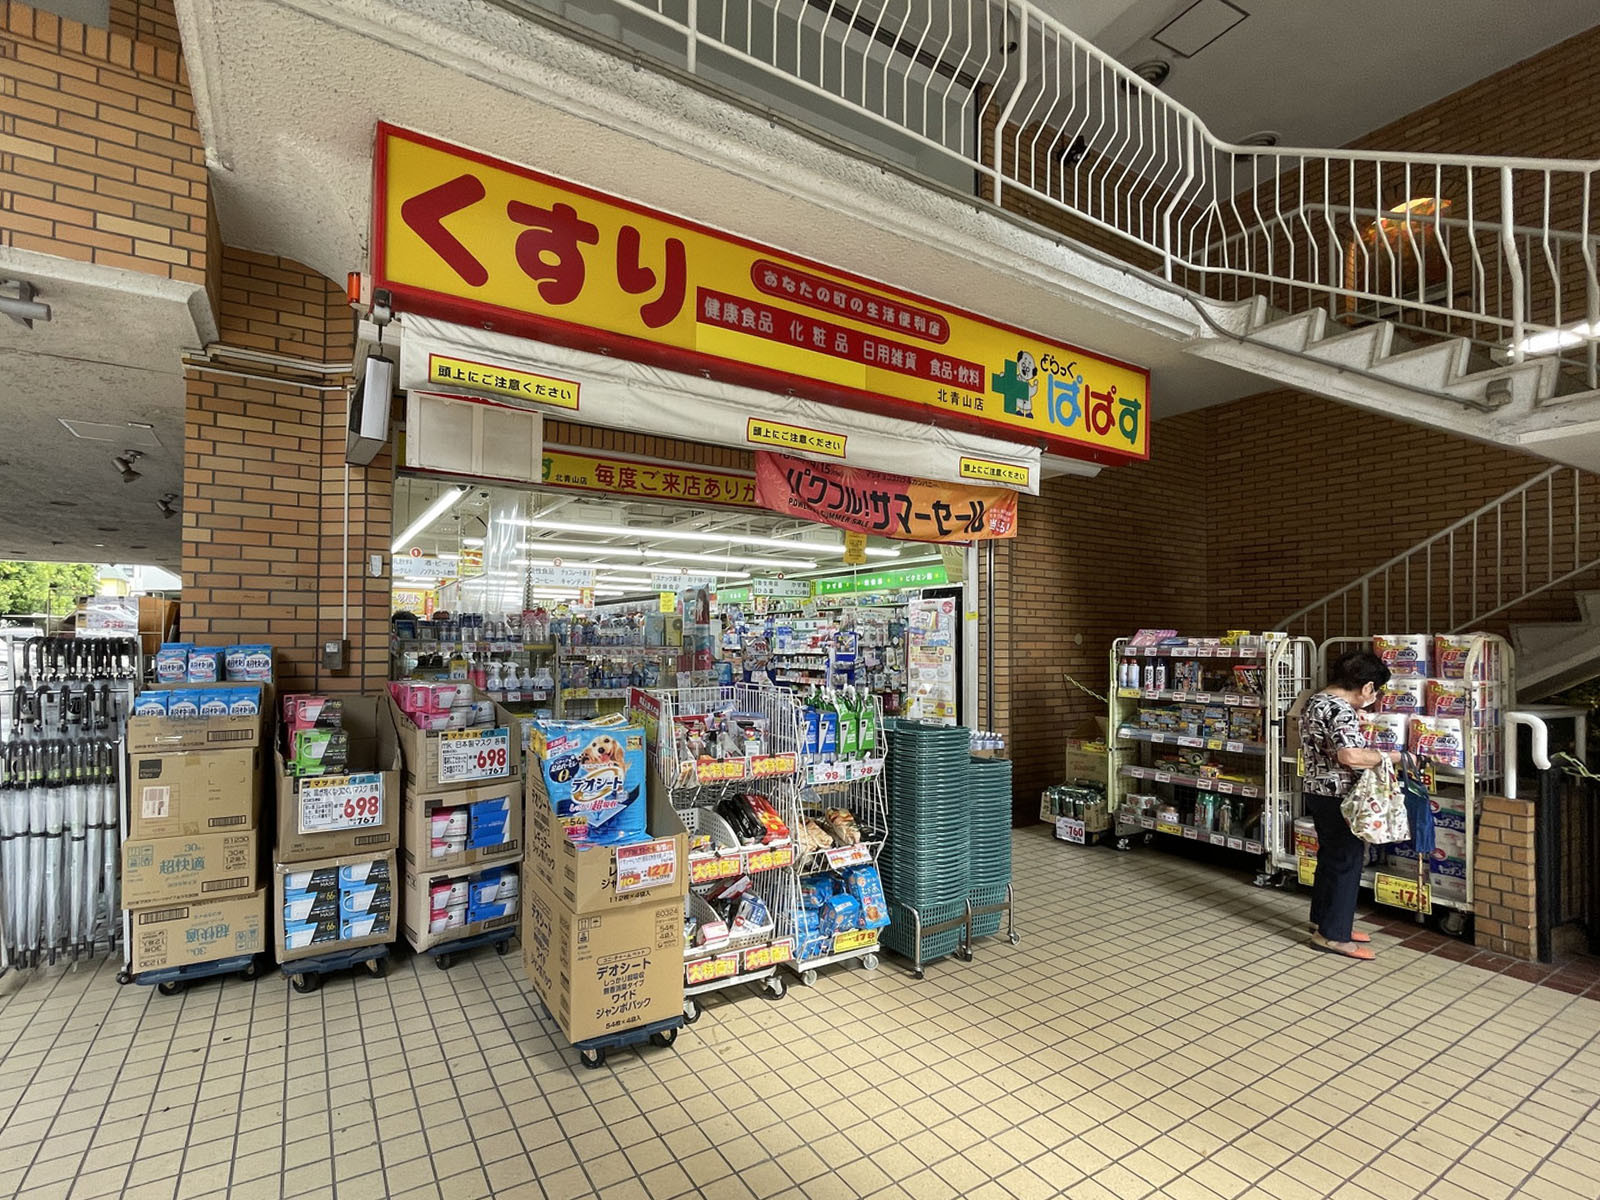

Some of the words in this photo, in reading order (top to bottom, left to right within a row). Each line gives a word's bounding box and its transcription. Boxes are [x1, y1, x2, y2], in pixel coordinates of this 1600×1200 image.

[401, 174, 687, 328] くすり
[763, 270, 941, 336] あなたの町の生活便利店
[704, 296, 774, 333] 健康食品
[790, 320, 848, 353] 化粧品
[863, 341, 917, 371] 日用雑貨
[930, 359, 980, 386] 食品・飲料
[1040, 354, 1077, 378] どらっぐ
[438, 365, 571, 400] 頭上にご注意ください
[937, 388, 984, 411] 北青山店
[1047, 374, 1142, 444] ぱぱす
[753, 426, 840, 450] 頭上にご注意ください
[556, 473, 588, 485] 北青山店
[963, 464, 1025, 480] 頭上にご注意ください
[477, 748, 506, 769] 698
[488, 767, 504, 775] 767
[825, 771, 839, 780] 98
[861, 766, 873, 775] 98
[572, 777, 623, 793] デオシート
[344, 796, 379, 818] 698
[358, 816, 376, 825] 767
[1068, 826, 1083, 837] 760
[159, 856, 205, 875] 超快適
[597, 958, 651, 980] デオシート
[611, 989, 636, 1004] ワイド
[596, 997, 651, 1019] ジャンボパック
